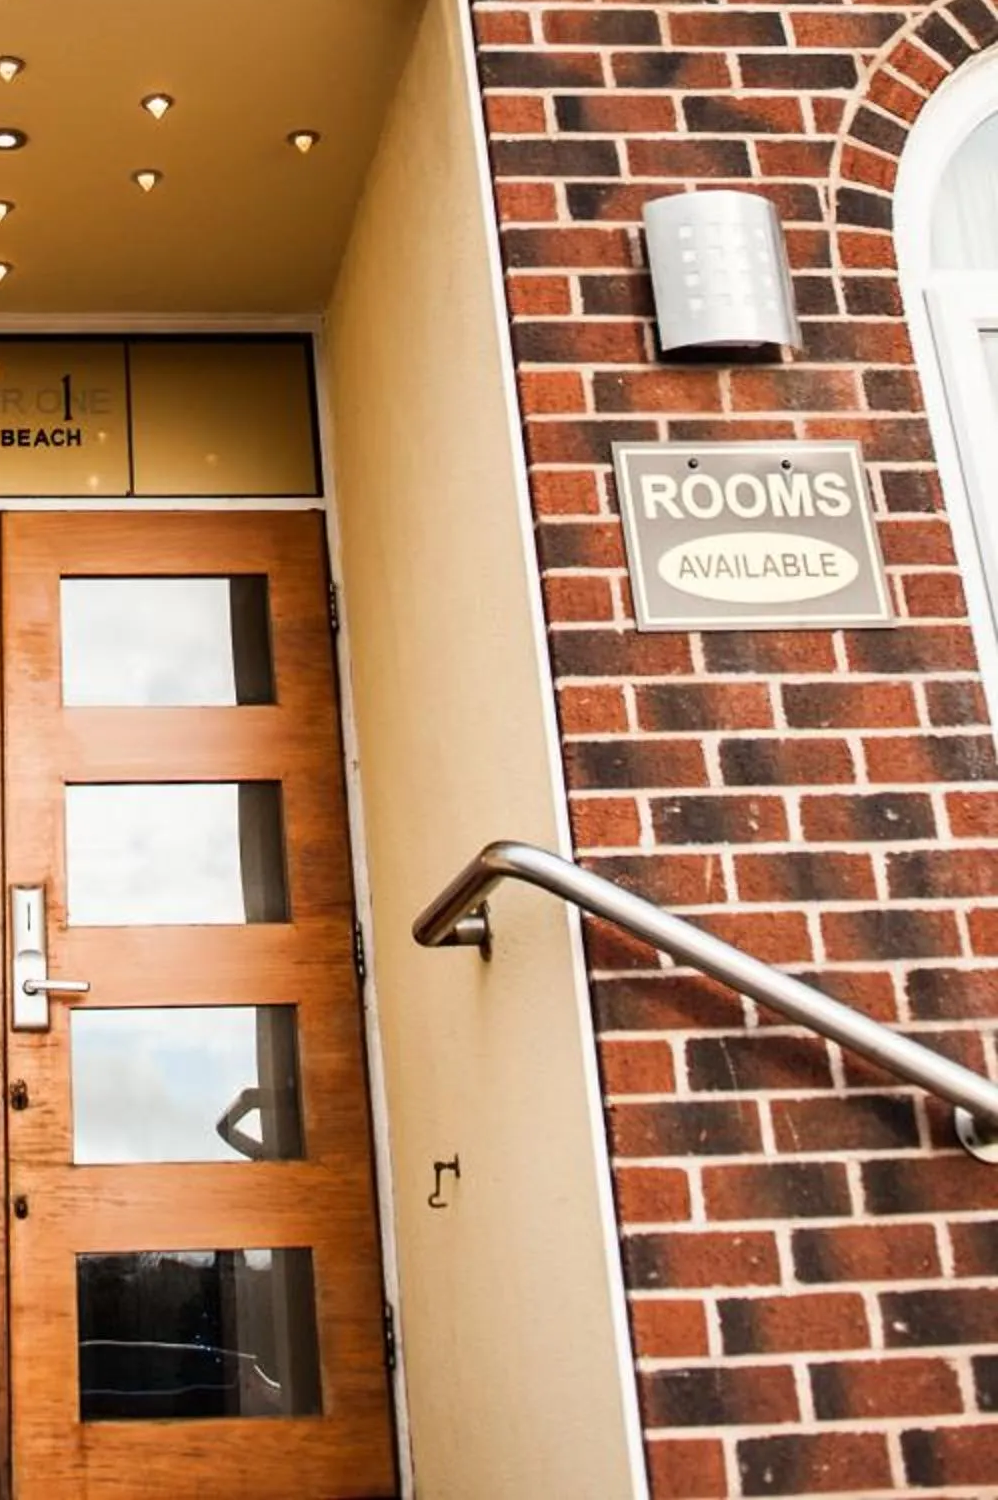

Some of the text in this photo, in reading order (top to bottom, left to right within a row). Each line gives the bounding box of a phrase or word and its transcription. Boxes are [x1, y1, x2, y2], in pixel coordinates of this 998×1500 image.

[0, 428, 82, 447] BEACH
[639, 472, 852, 519] ROOMS
[678, 553, 840, 579] AVAILABLE
